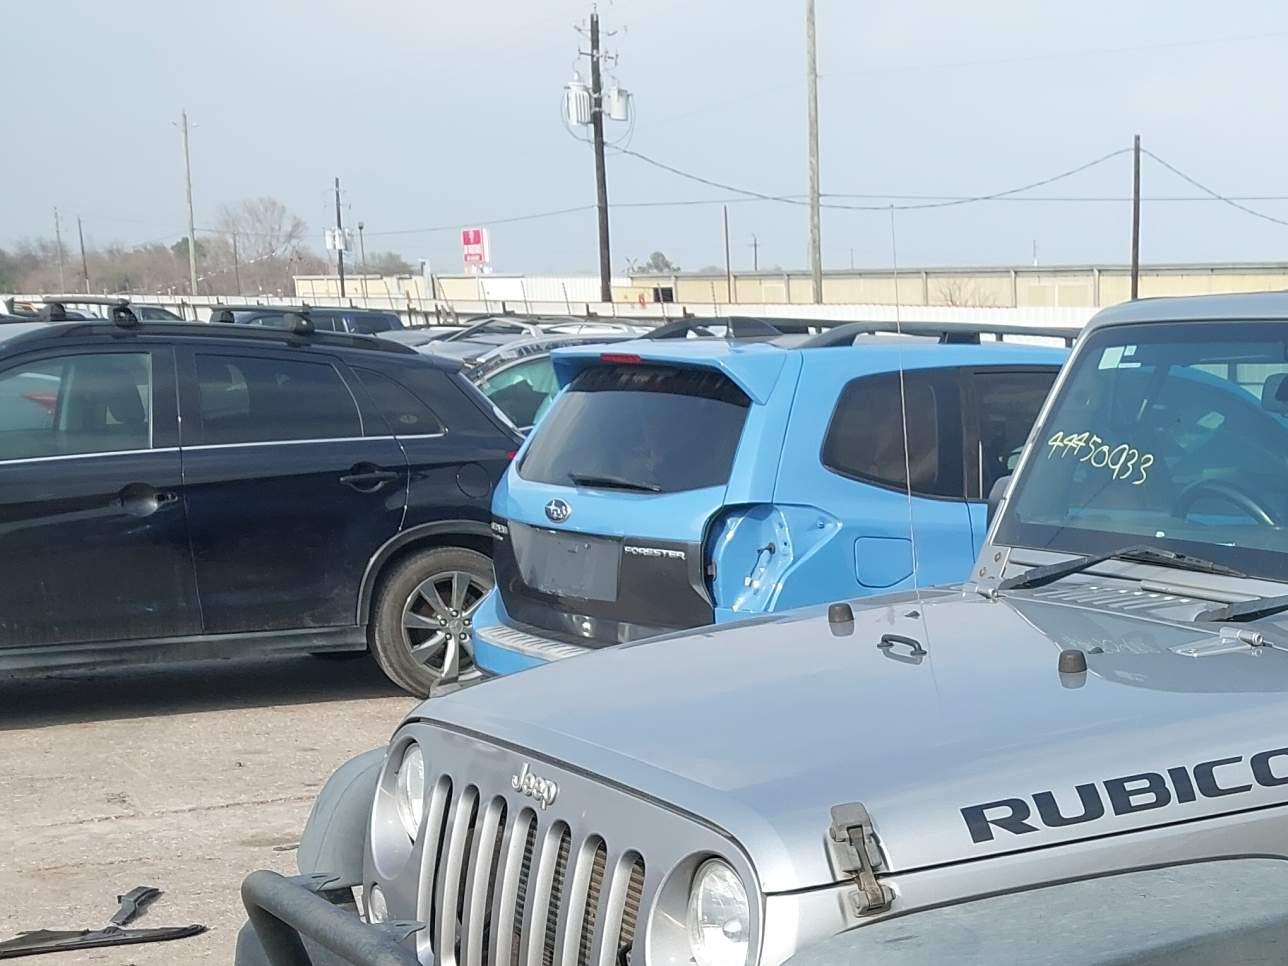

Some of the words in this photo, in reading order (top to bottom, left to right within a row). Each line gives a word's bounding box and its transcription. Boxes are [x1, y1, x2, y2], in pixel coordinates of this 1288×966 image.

[1048, 432, 1153, 485] 44450933
[624, 546, 686, 560] FORESTER
[512, 763, 558, 810] Jeep
